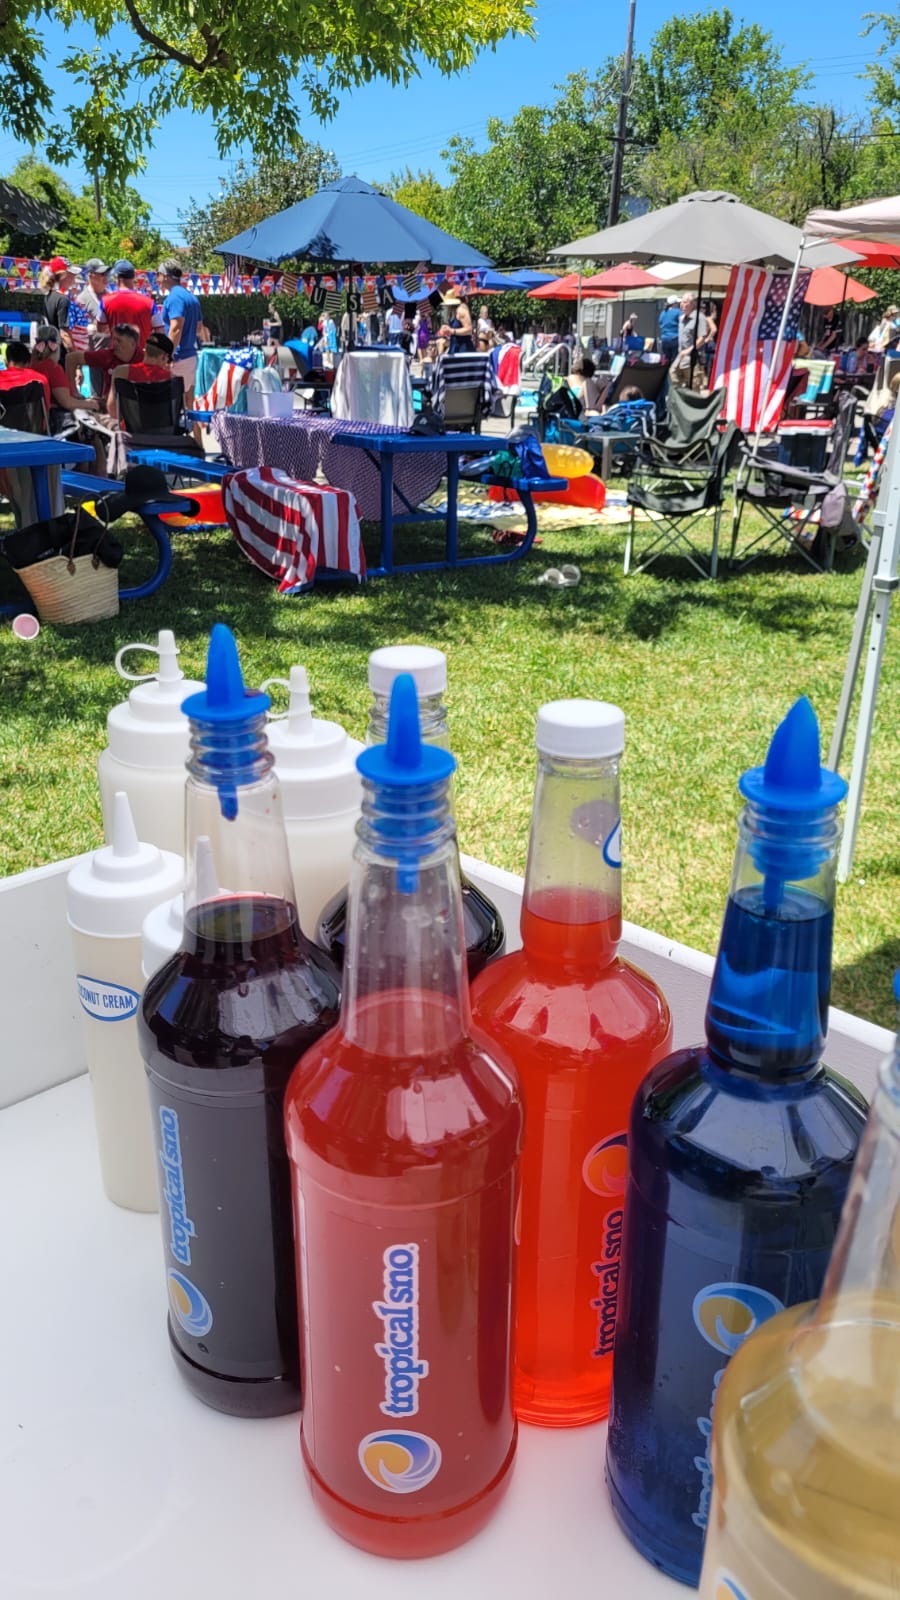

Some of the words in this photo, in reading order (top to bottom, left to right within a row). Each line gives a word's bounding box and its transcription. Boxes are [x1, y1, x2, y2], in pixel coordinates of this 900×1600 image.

[102, 994, 134, 1009] CREAM
[161, 1109, 179, 1164] sno
[160, 1156, 193, 1263] tropical
[605, 1210, 625, 1260] sno
[388, 1248, 414, 1304] sno
[377, 1305, 424, 1414] tropical
